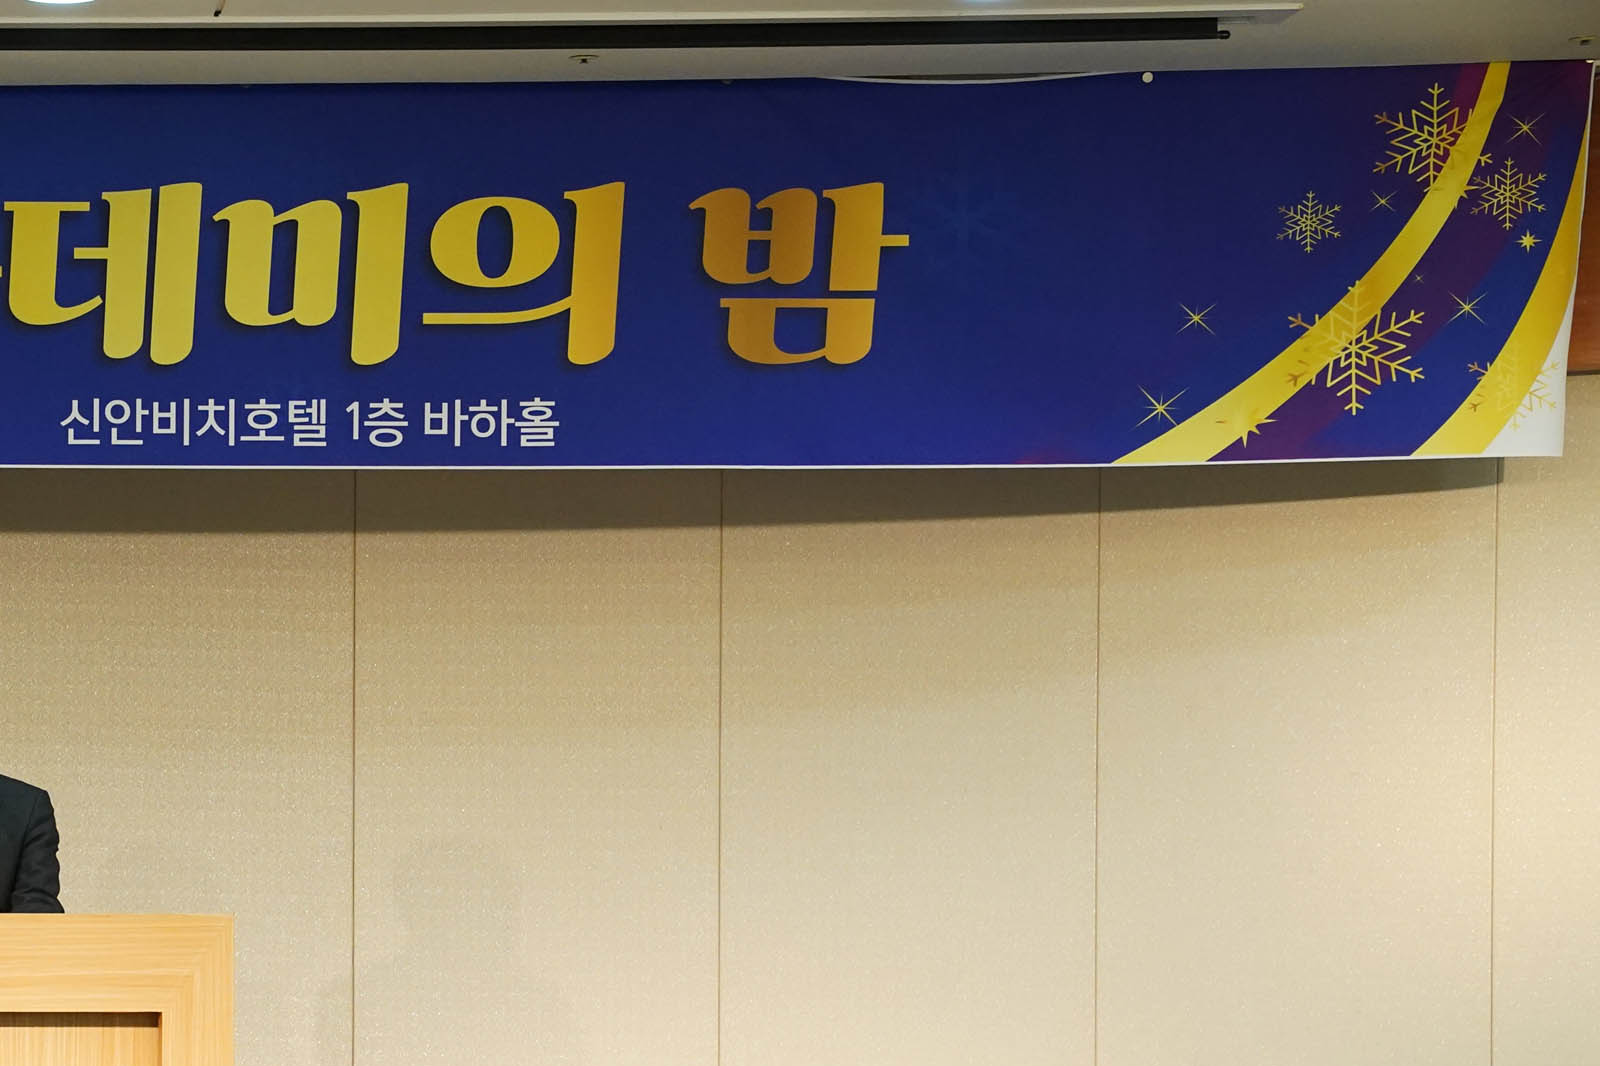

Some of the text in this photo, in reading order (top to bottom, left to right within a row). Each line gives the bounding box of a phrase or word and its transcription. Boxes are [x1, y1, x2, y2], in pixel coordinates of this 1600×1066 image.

[690, 183, 909, 364] 밤
[61, 398, 327, 447] 신안비치호텔
[346, 398, 409, 447] 1층
[425, 398, 560, 447] 바하홀
